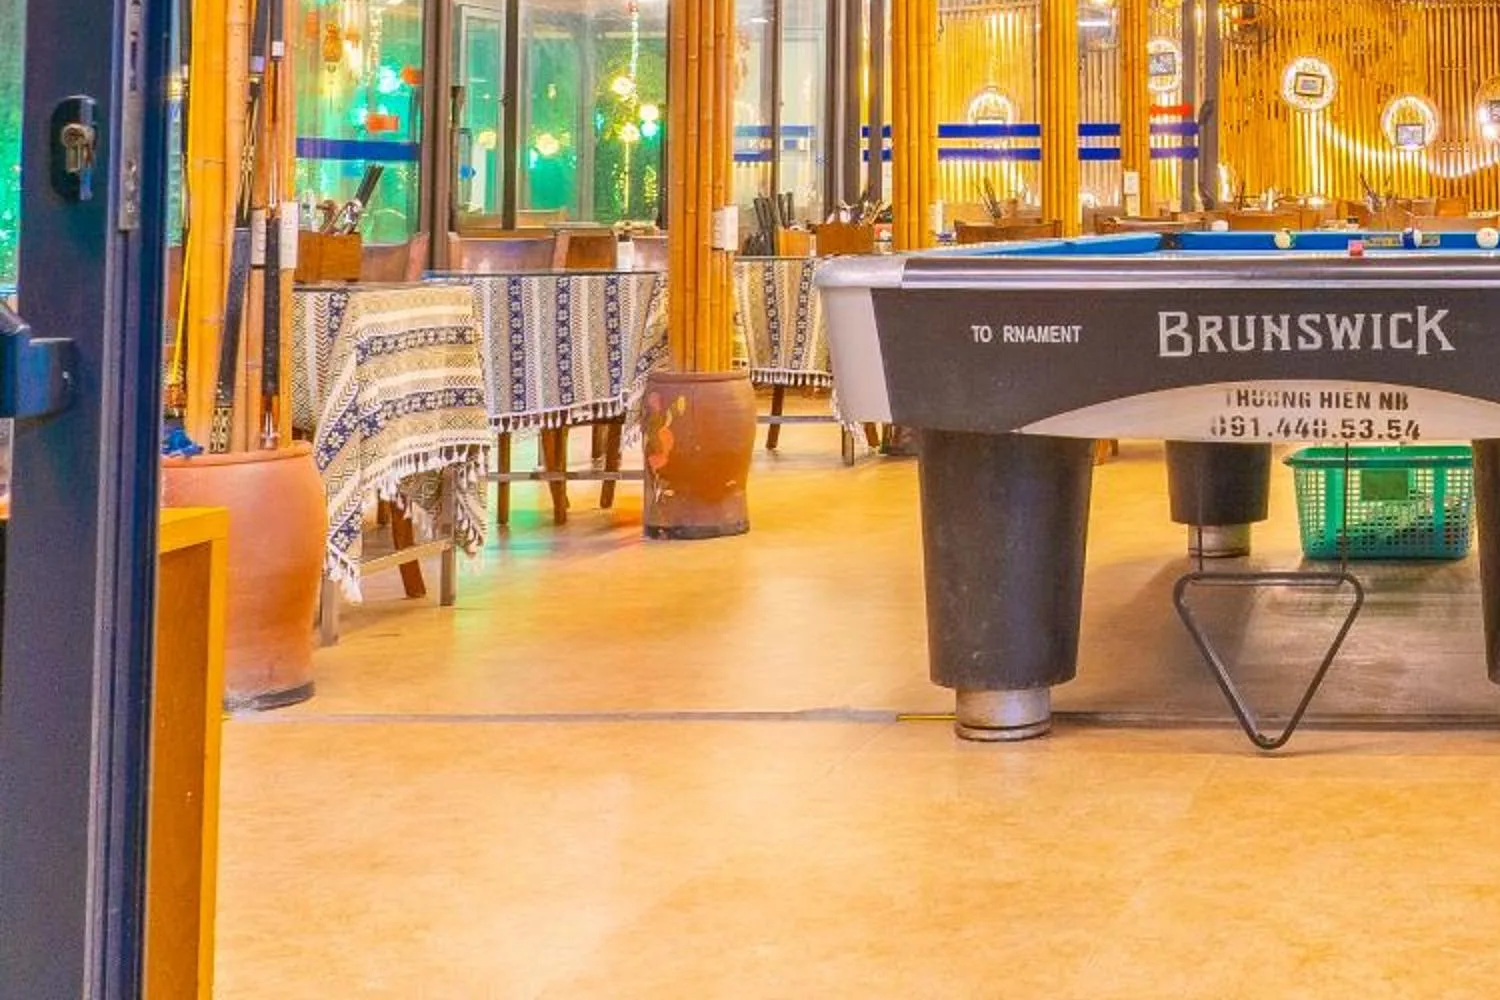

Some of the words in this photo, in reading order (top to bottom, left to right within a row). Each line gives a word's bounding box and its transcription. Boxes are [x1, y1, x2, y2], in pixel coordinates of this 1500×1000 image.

[1157, 305, 1456, 357] BRUNSWICK
[1319, 390, 1371, 410] HIEN
[1379, 390, 1409, 411] NB
